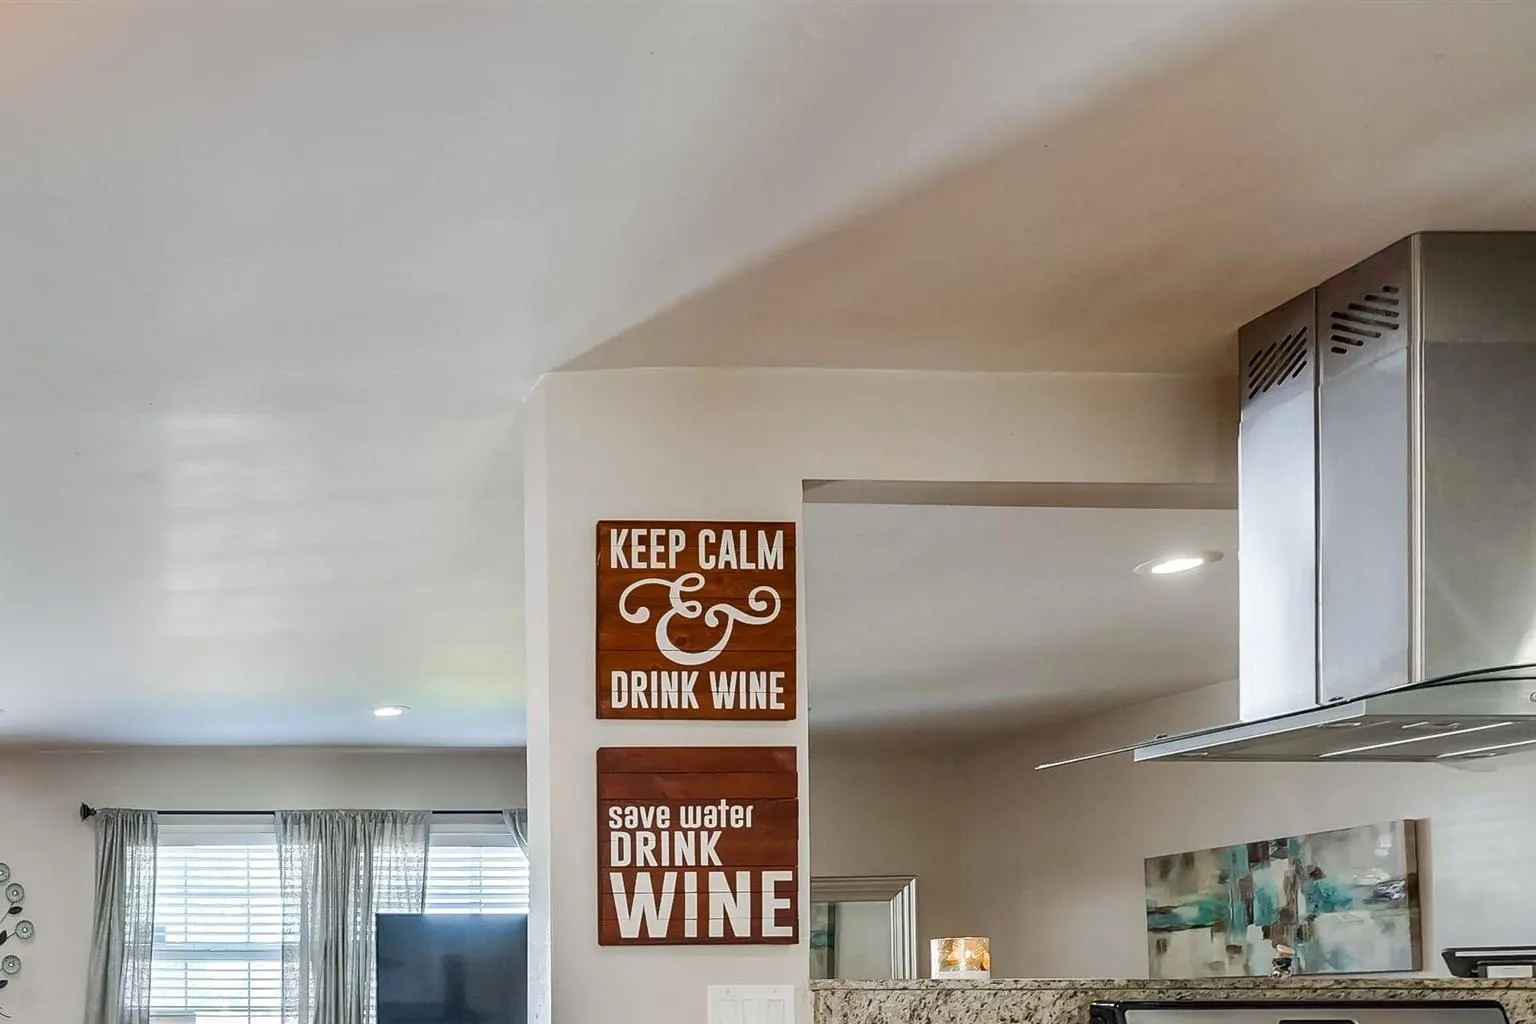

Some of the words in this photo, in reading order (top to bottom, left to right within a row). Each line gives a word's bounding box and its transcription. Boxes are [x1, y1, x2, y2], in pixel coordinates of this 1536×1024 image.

[610, 529, 686, 569] KEEP
[698, 529, 784, 570] CALM
[619, 573, 782, 665] &
[611, 671, 699, 709] DRINK
[710, 671, 785, 710] WINE
[608, 805, 671, 828] save
[679, 799, 754, 828] water
[610, 831, 722, 867] DRINK
[609, 871, 793, 938] WINE
